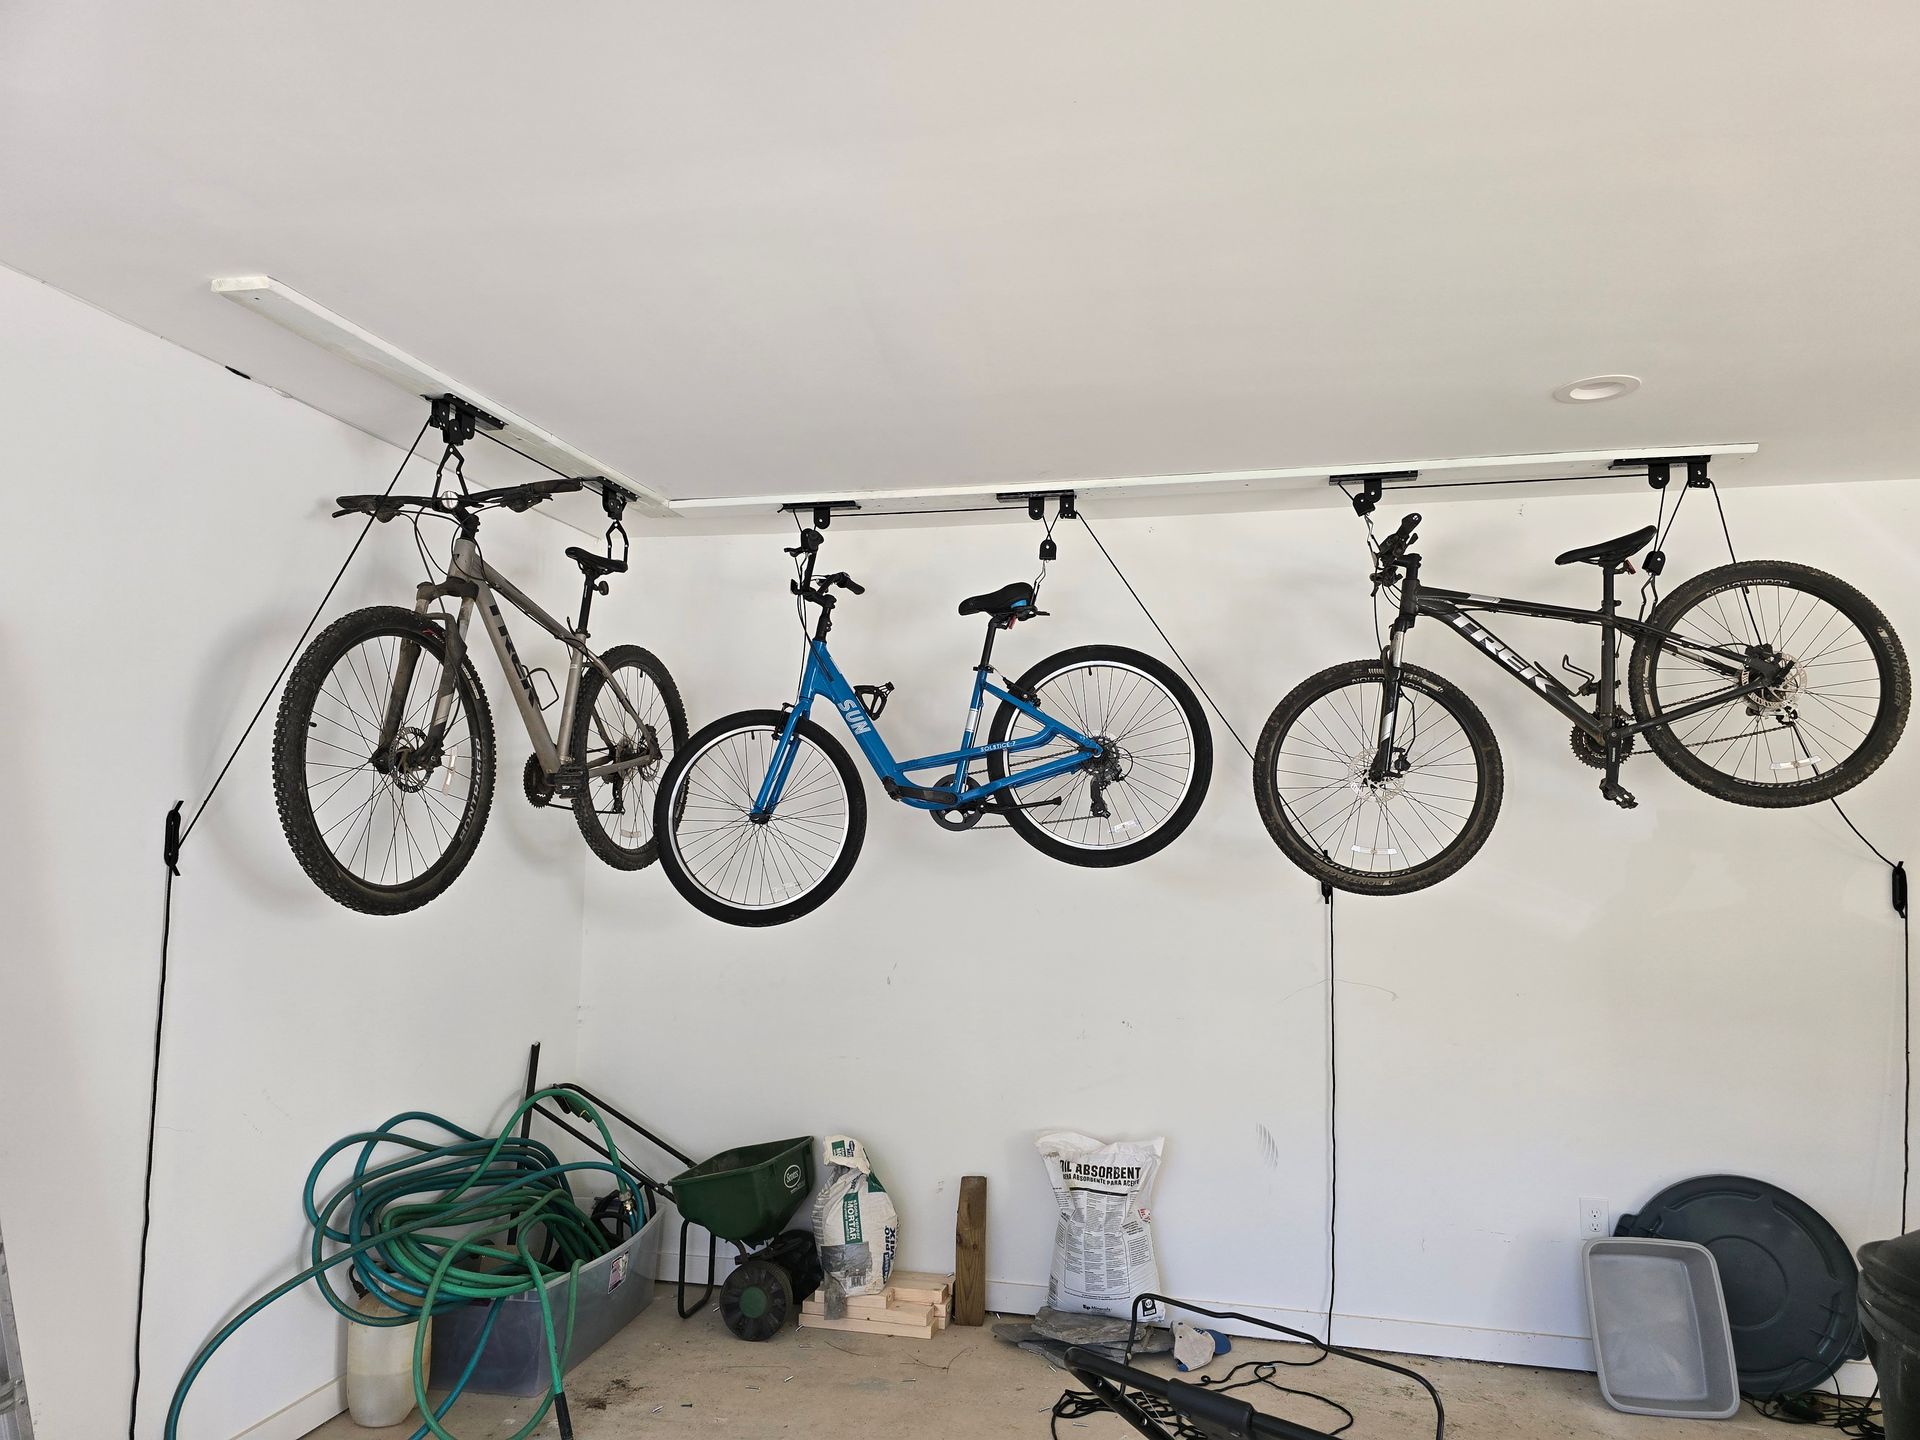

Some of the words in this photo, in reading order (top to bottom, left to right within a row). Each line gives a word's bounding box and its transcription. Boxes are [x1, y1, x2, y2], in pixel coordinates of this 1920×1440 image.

[1452, 614, 1556, 693] TREK
[1882, 636, 1903, 707] BONTRAGER
[837, 699, 872, 735] SUN
[1075, 1163, 1141, 1180] ABSORBENT
[847, 1200, 857, 1241] MORTAR
